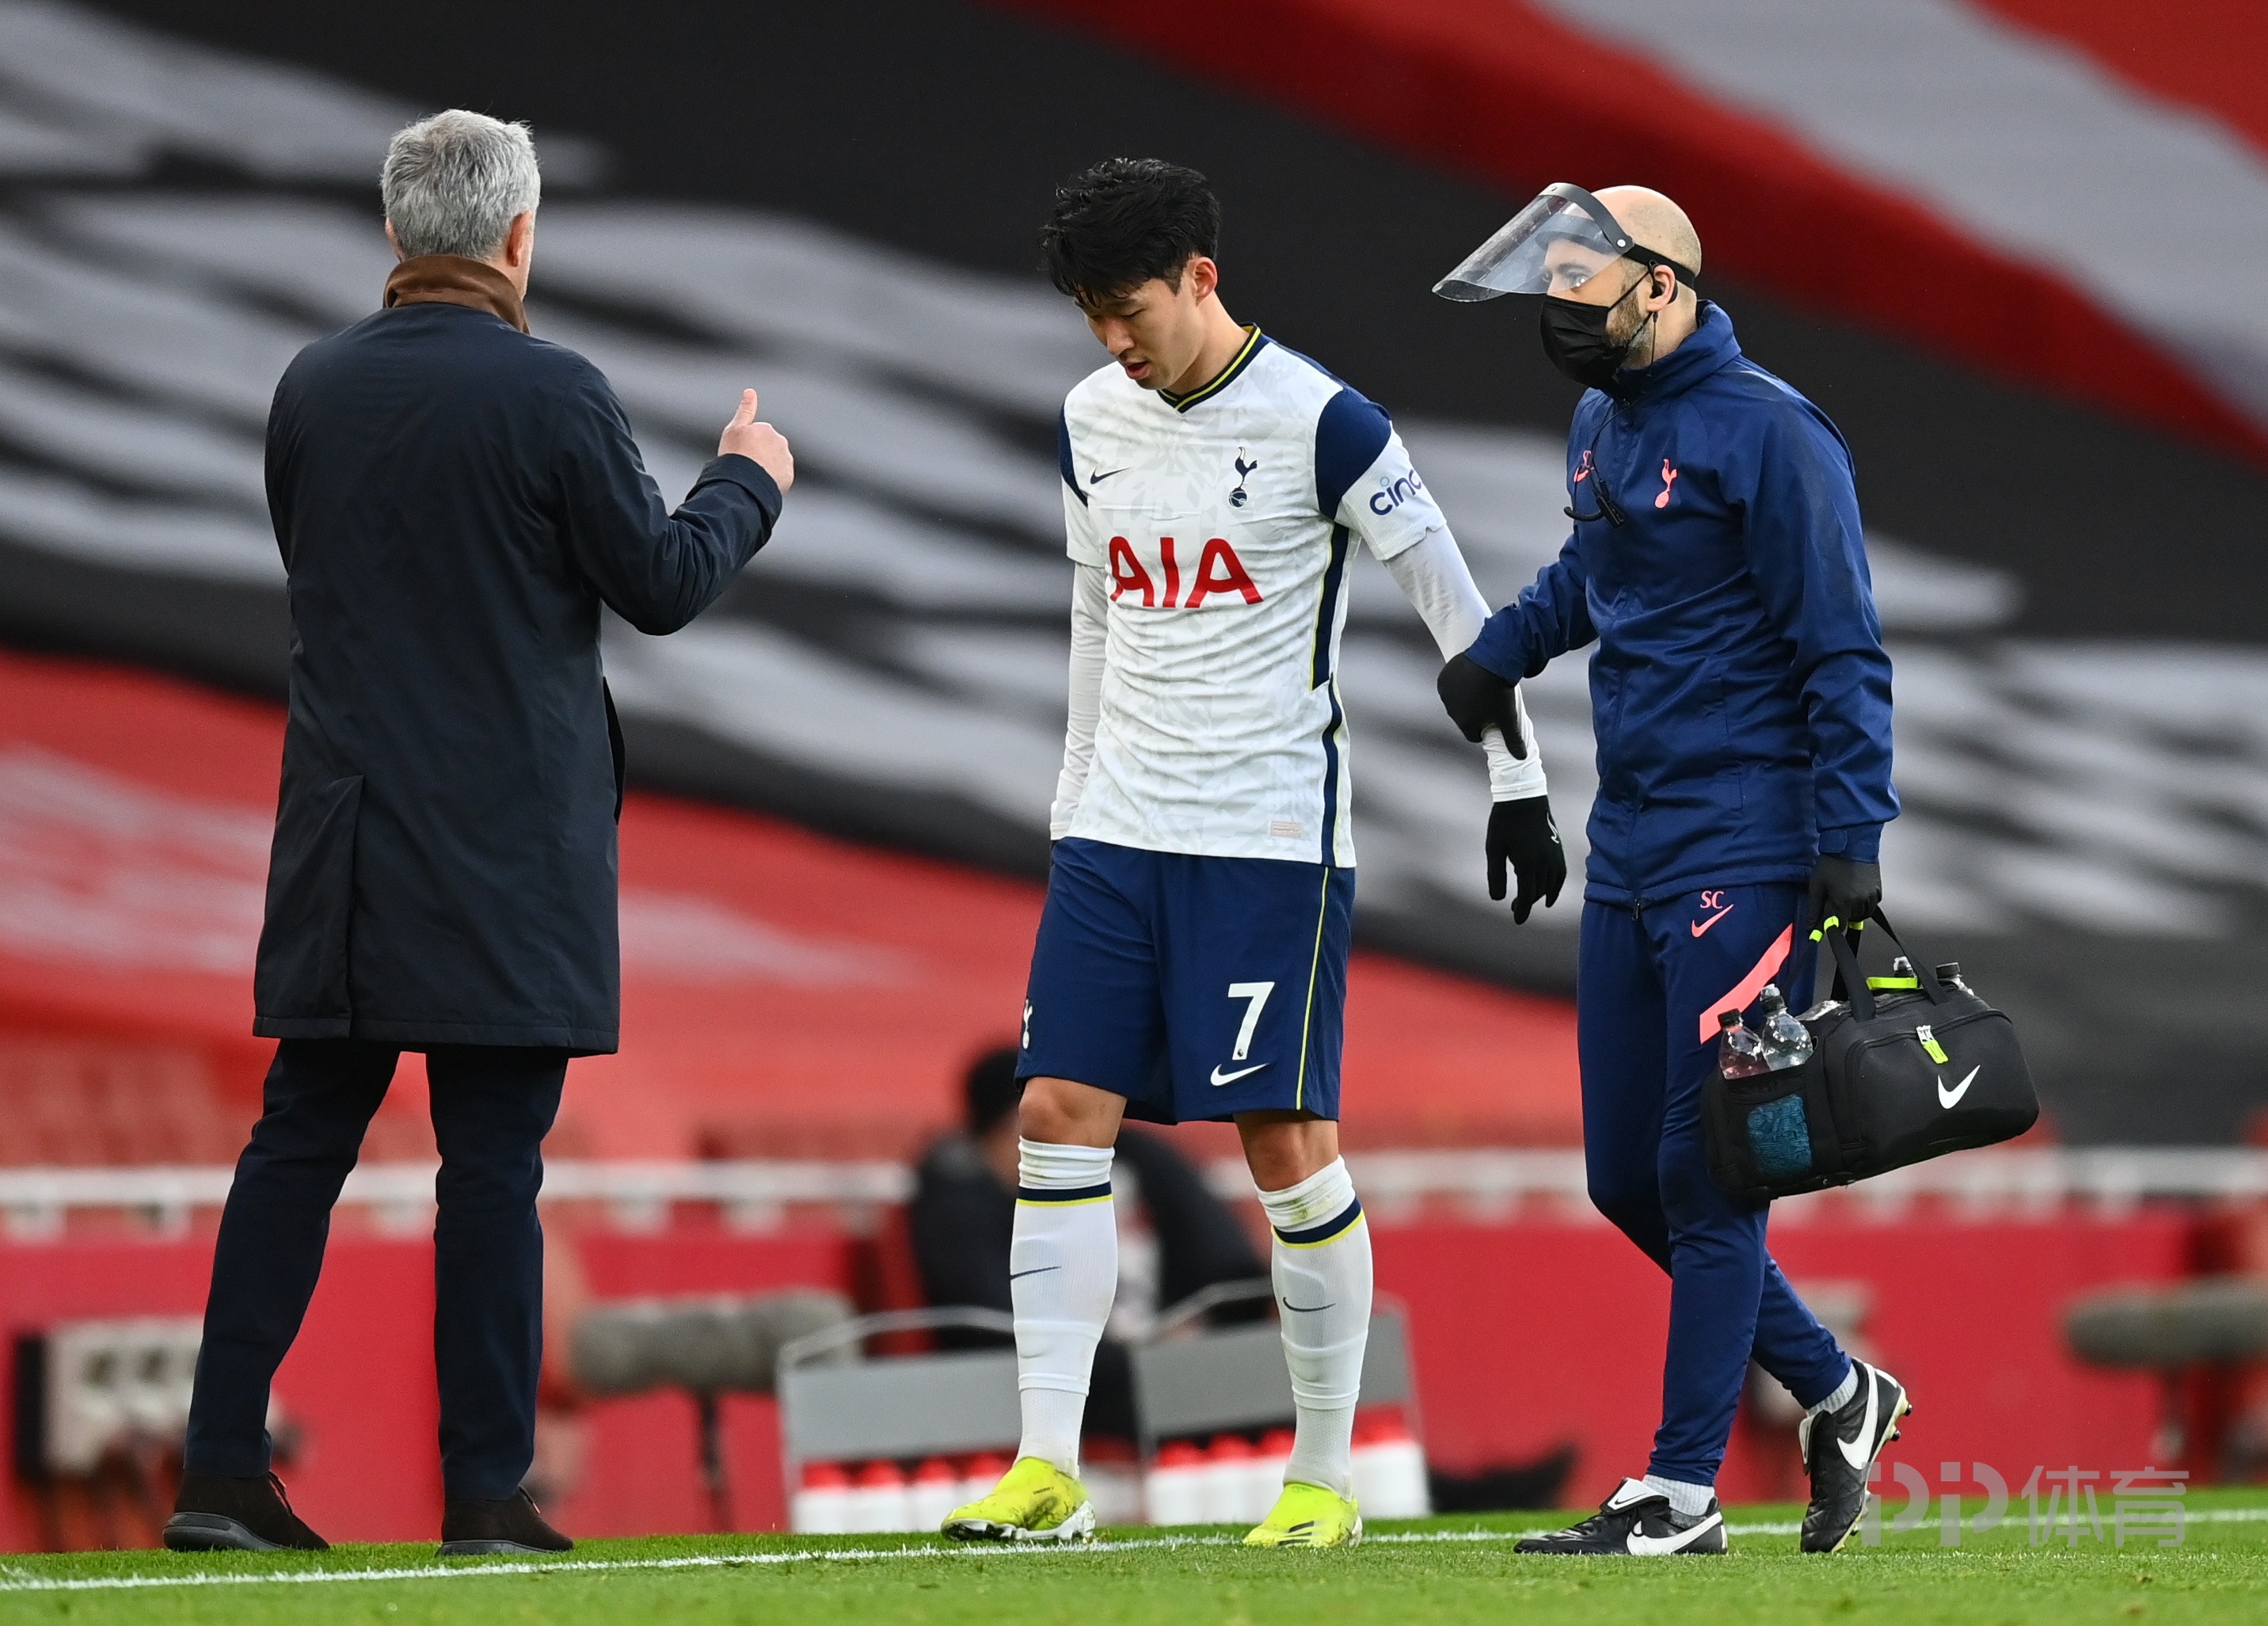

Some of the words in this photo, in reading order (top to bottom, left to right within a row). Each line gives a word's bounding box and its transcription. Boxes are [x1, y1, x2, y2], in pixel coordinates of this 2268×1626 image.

[1109, 536, 1265, 608] AIA
[1699, 890, 1725, 909] SC
[1227, 981, 1275, 1061] 7
